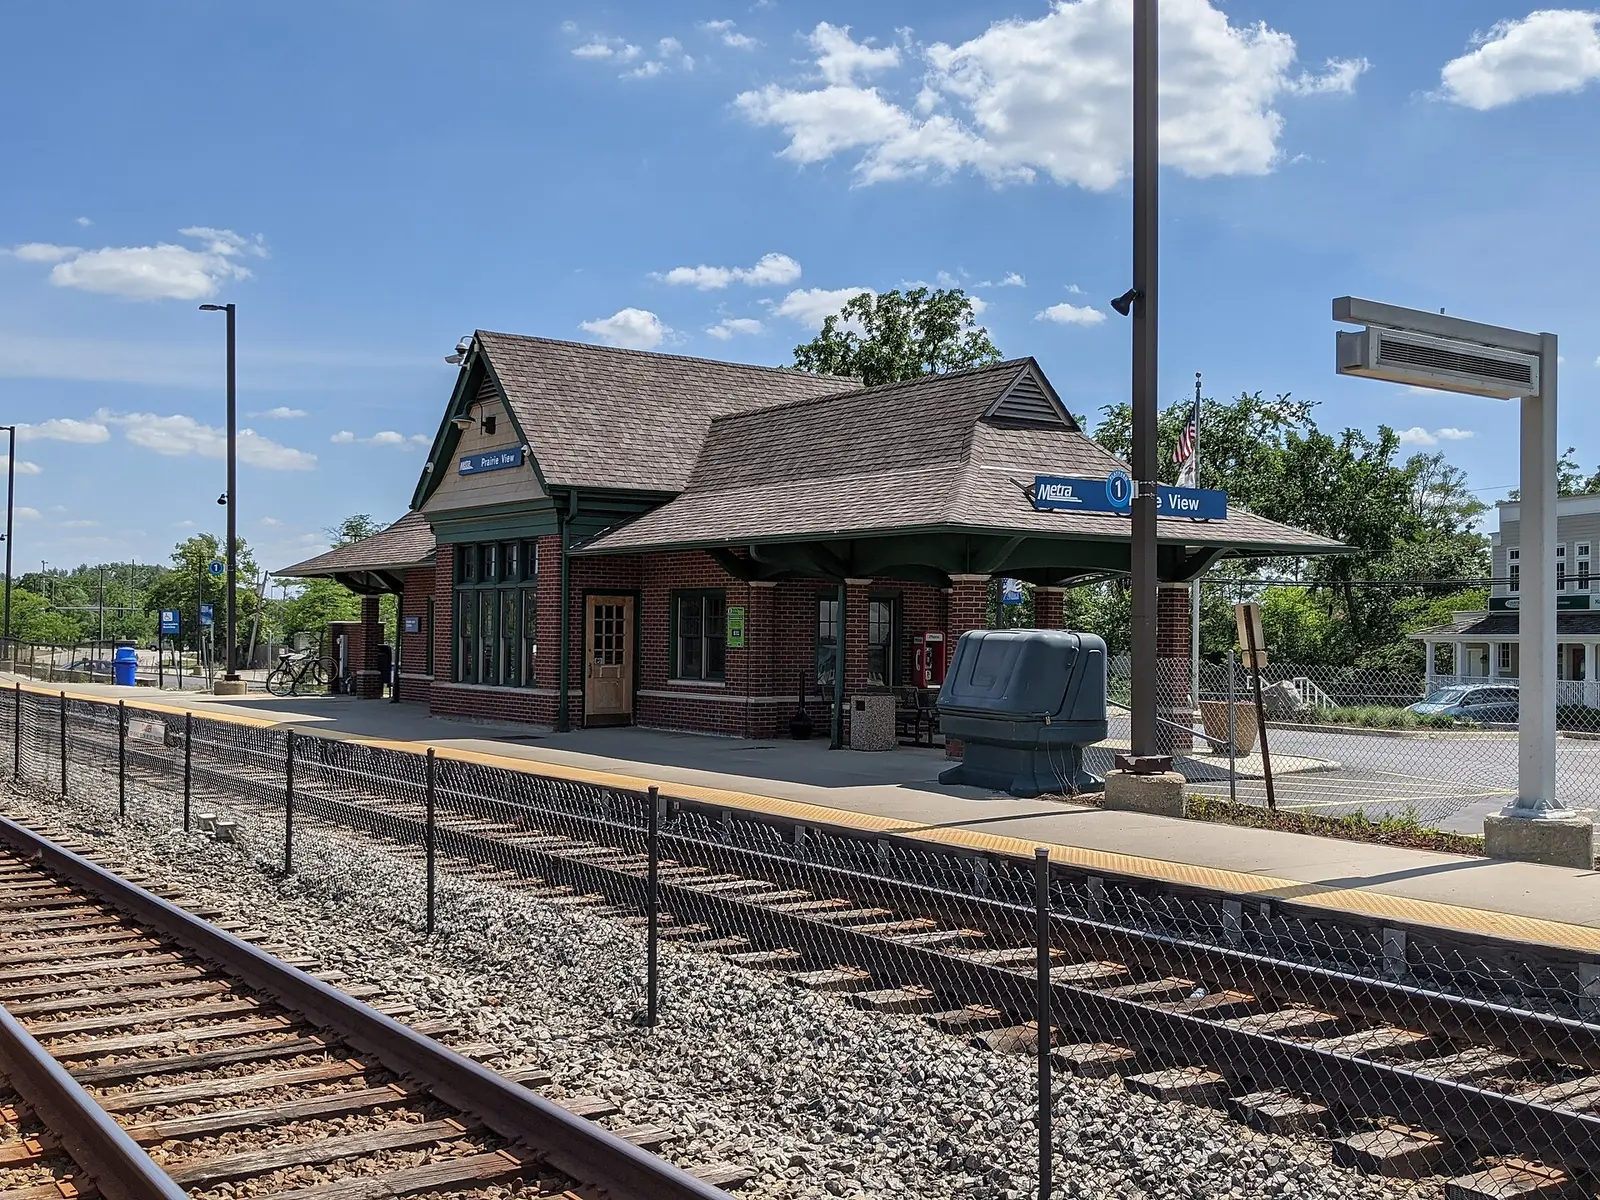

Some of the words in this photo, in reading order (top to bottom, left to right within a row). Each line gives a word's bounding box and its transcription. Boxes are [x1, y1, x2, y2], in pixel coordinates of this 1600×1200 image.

[481, 456, 499, 467] Prairie
[501, 453, 515, 464] View
[1037, 484, 1074, 501] Metra
[1115, 480, 1121, 498] 1
[1168, 493, 1200, 511] View
[214, 564, 218, 572] 1
